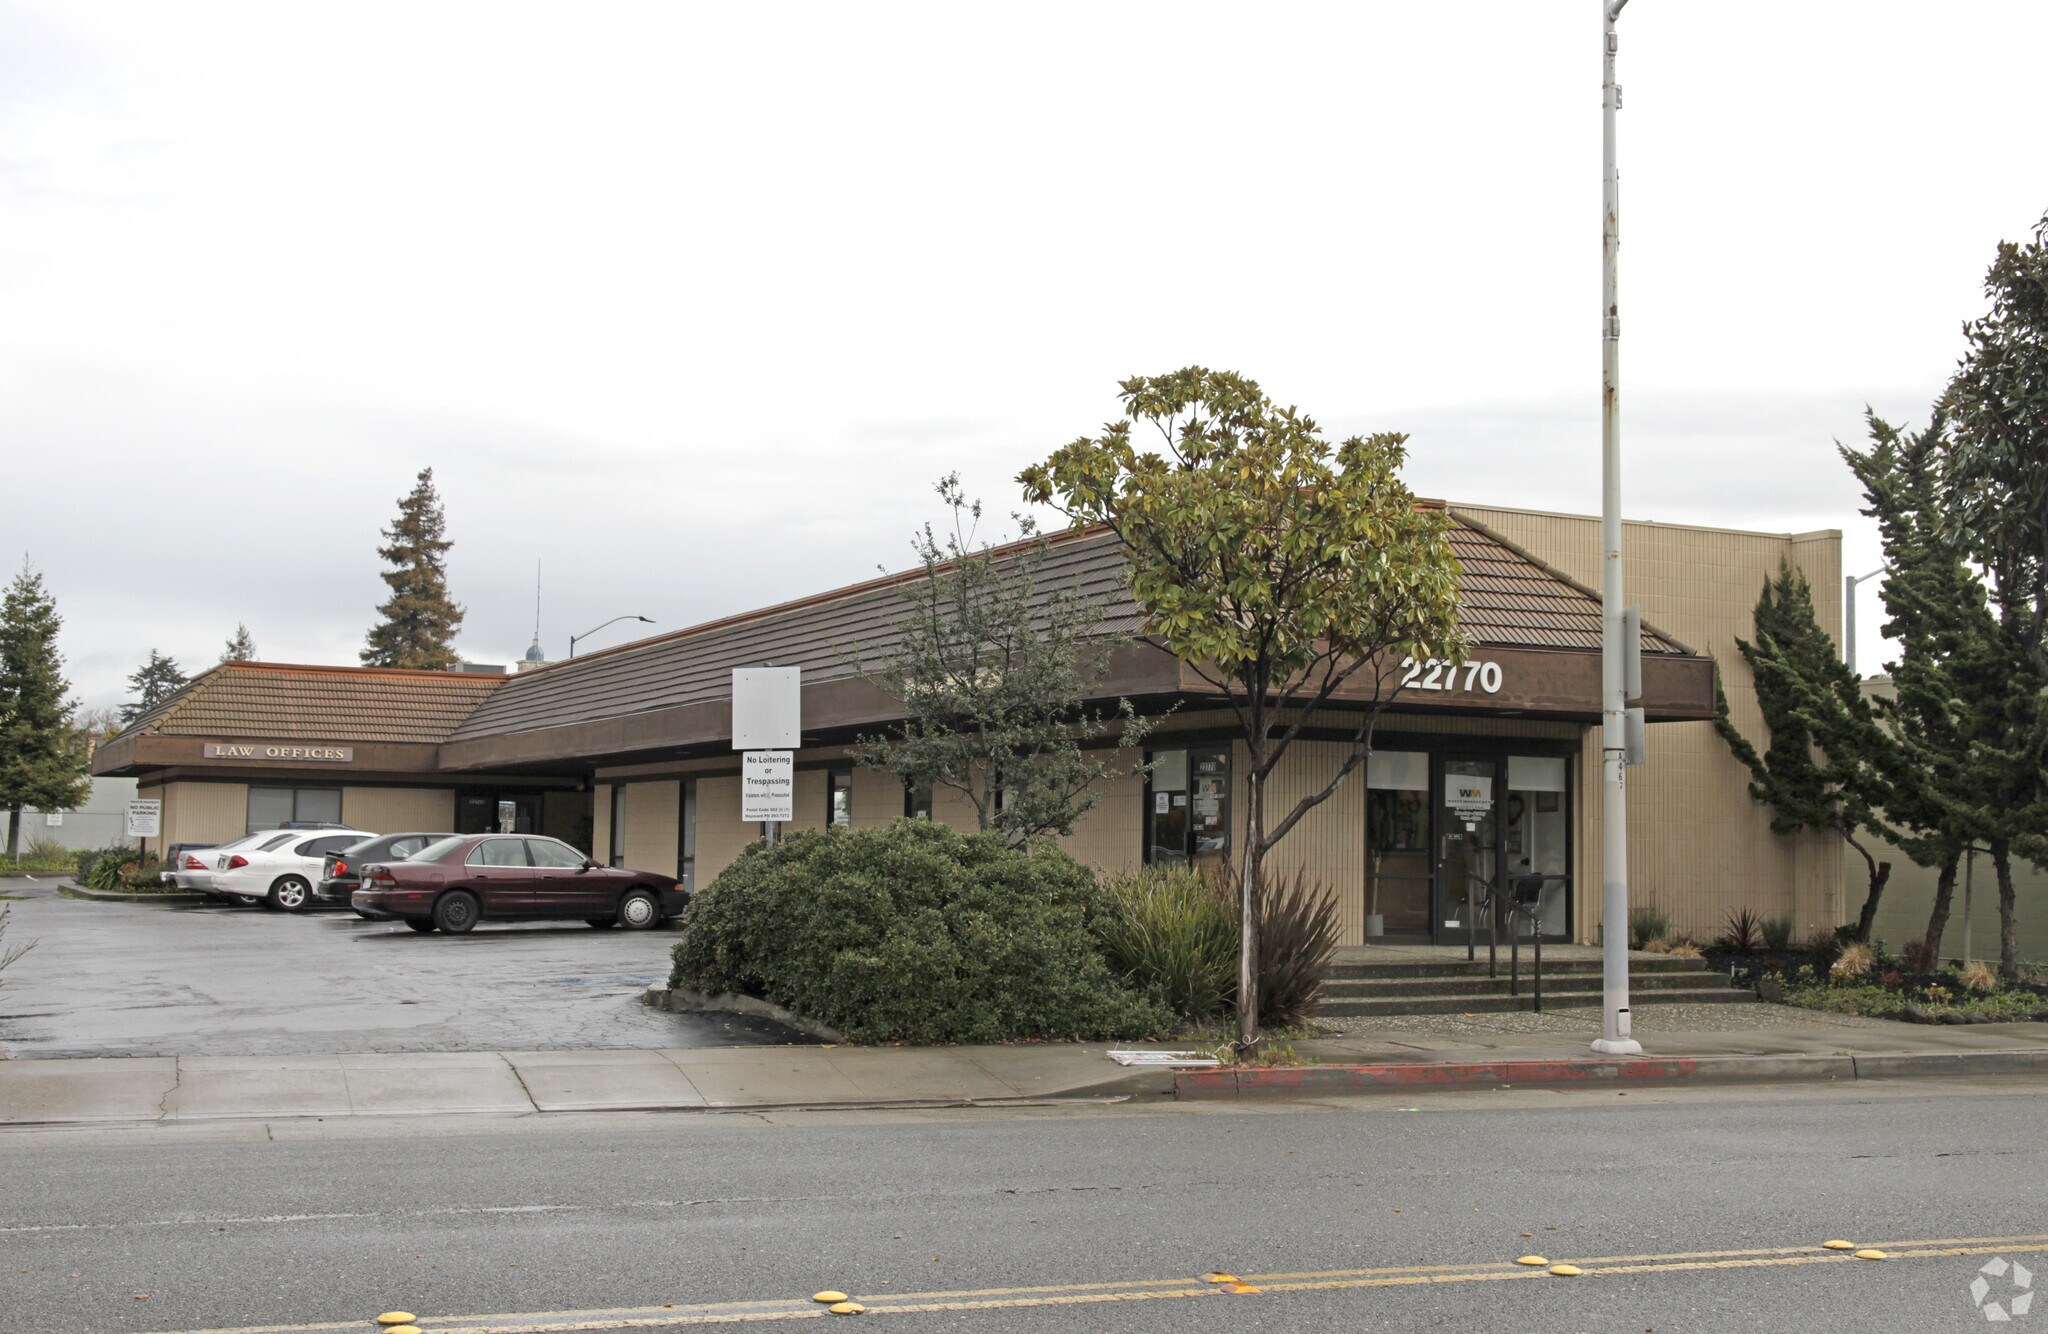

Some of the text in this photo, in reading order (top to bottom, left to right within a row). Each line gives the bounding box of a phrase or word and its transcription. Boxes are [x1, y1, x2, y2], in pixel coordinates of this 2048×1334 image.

[1400, 656, 1503, 694] 22770
[215, 745, 344, 760] LAW OFFICES
[759, 756, 790, 764] Loitering
[747, 777, 790, 786] Trespassing
[1459, 789, 1482, 798] WM
